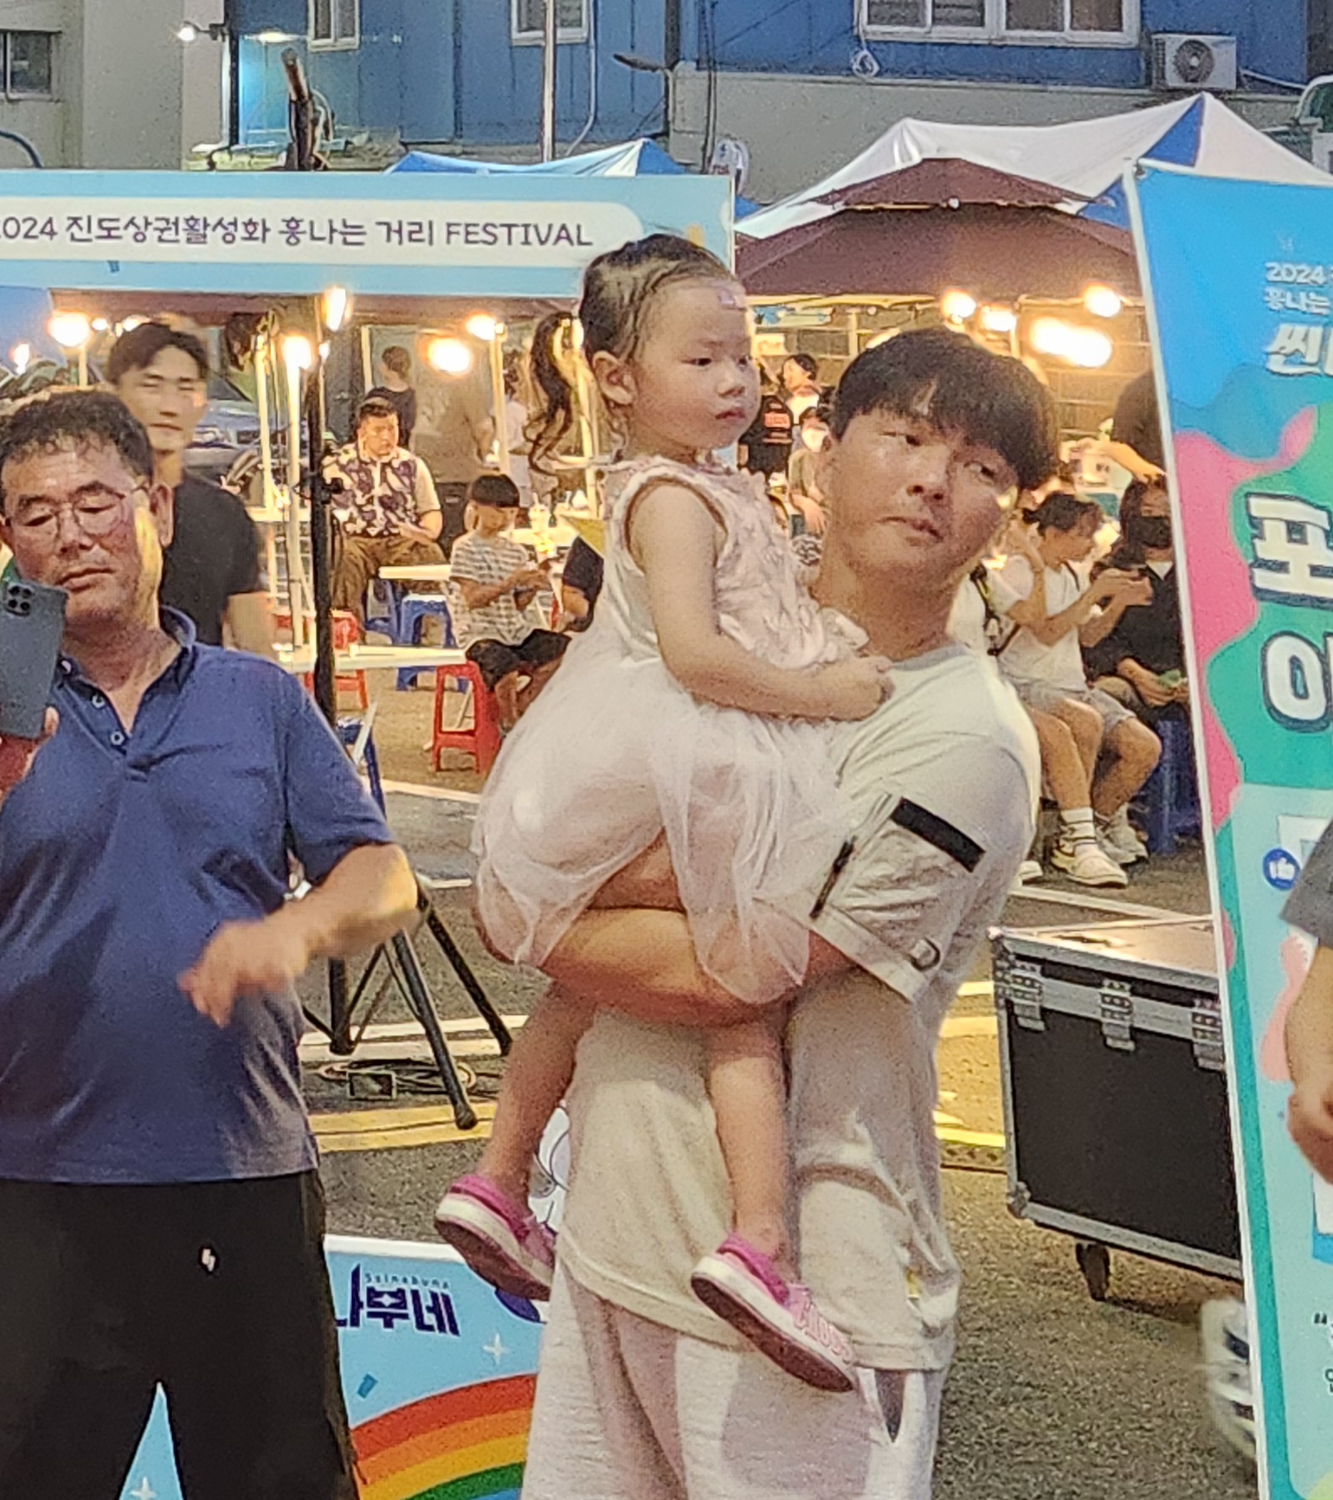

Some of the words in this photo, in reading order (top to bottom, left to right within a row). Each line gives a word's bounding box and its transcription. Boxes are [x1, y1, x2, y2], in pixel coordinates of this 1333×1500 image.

[64, 214, 271, 245] 진도상권활성화
[278, 215, 368, 247] 흥나는
[375, 218, 435, 247] 거리
[444, 221, 594, 247] FESTIVAL
[1264, 261, 1327, 286] 2024
